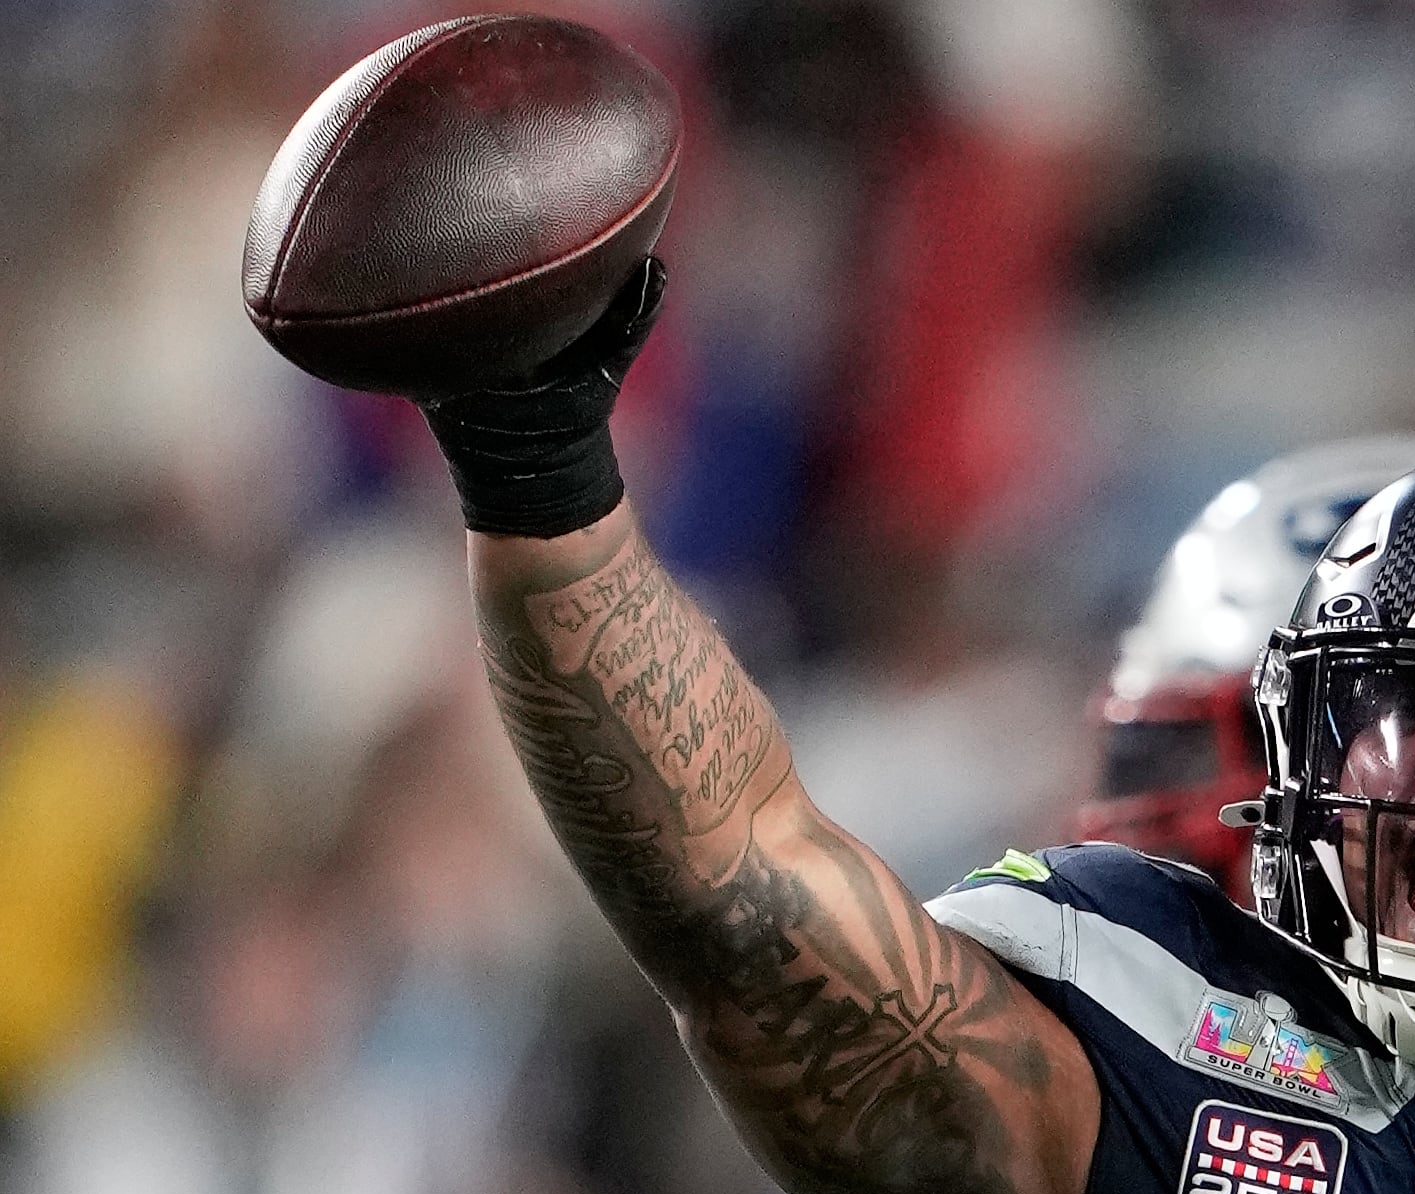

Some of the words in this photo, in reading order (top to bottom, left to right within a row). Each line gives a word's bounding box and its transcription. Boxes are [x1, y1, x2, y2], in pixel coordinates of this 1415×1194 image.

[1208, 1054, 1265, 1080] SUPER
[1273, 1077, 1322, 1099] BOWL
[1206, 1116, 1327, 1174] USA
